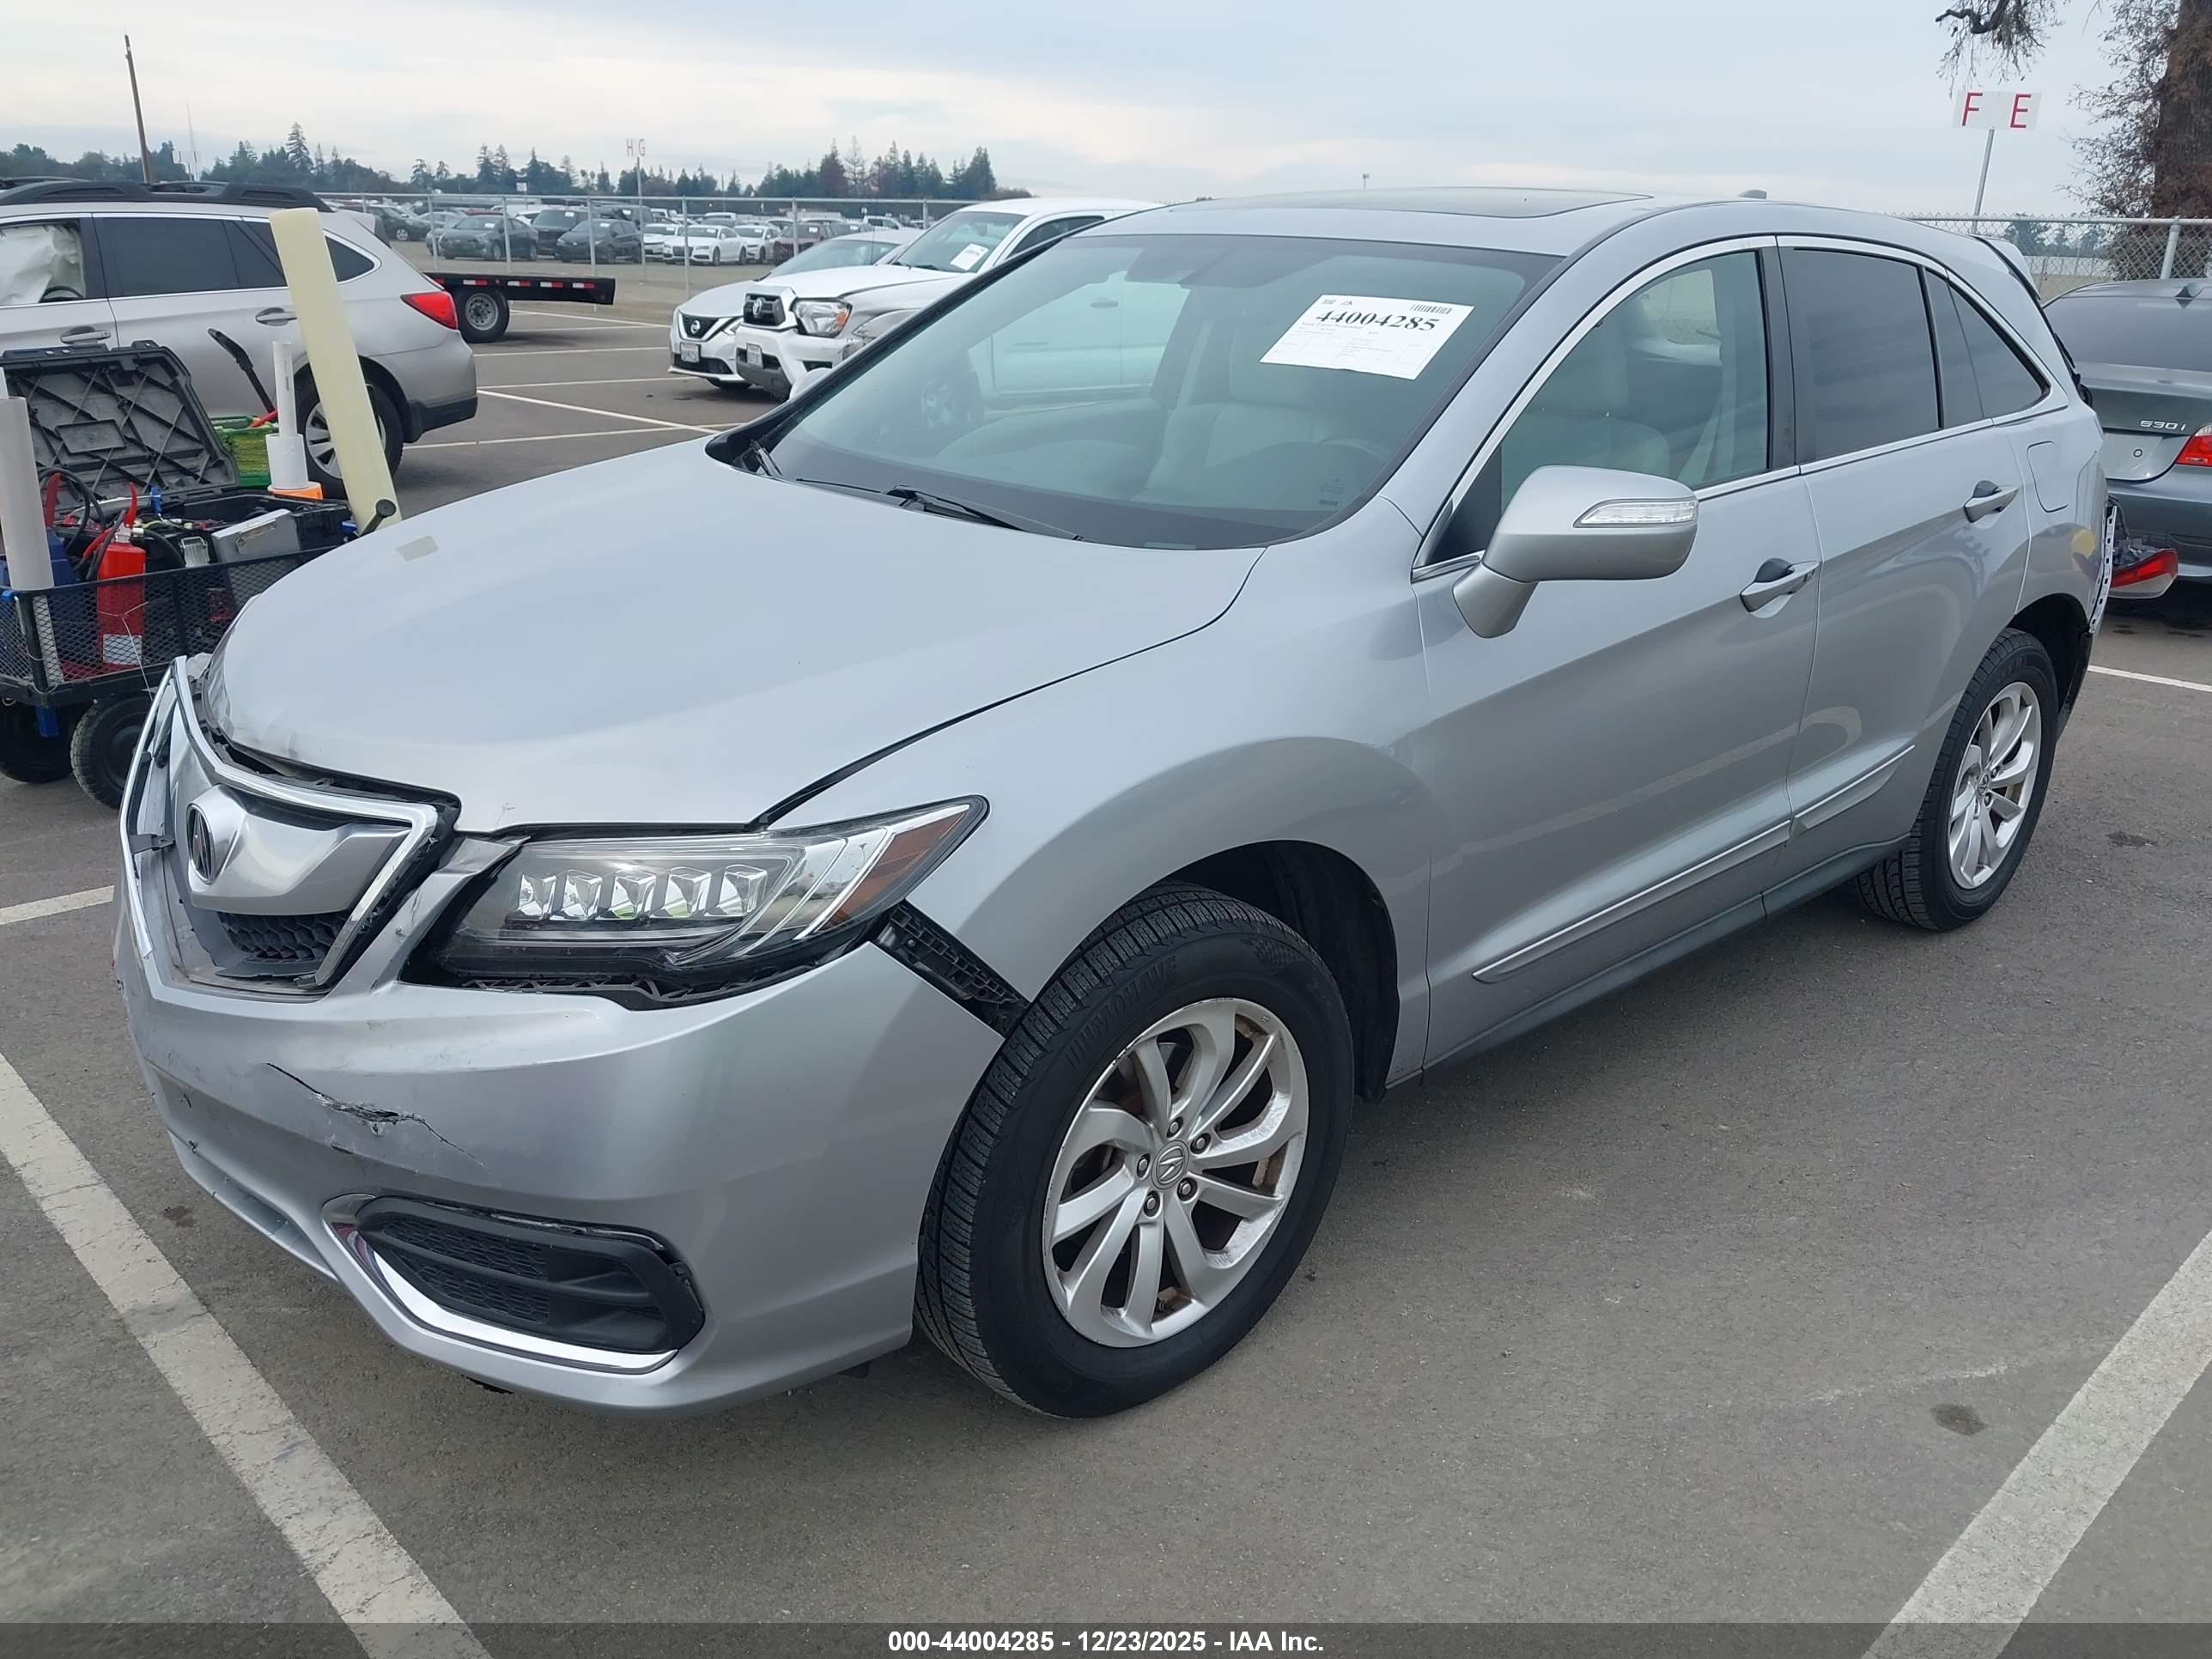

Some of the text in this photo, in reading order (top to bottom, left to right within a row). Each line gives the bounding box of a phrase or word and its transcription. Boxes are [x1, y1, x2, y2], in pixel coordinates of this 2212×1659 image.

[1962, 92, 2032, 128] F E
[1316, 309, 1440, 331] 44004285
